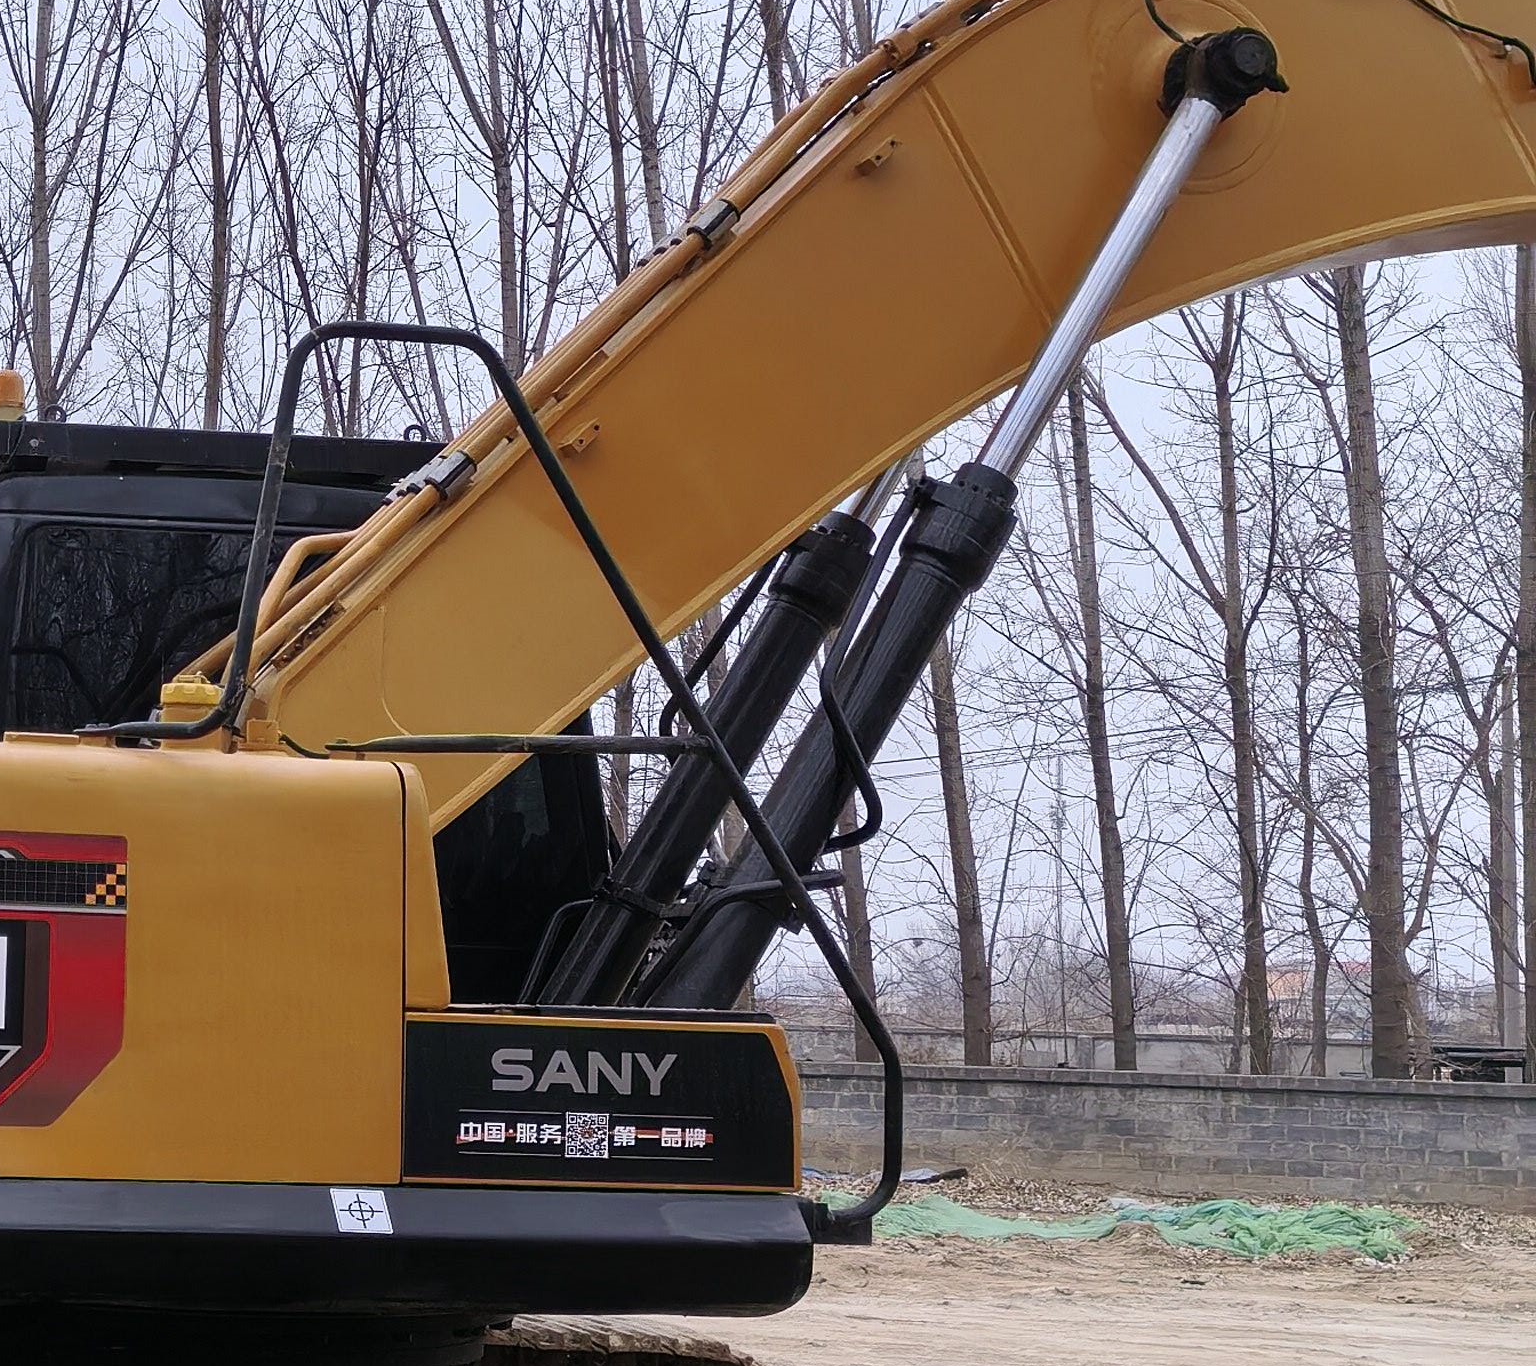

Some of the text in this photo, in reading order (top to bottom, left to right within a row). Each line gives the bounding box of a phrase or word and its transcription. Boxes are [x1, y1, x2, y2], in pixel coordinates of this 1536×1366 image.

[491, 1048, 678, 1096] SANY
[614, 1125, 706, 1148] 第一品牌
